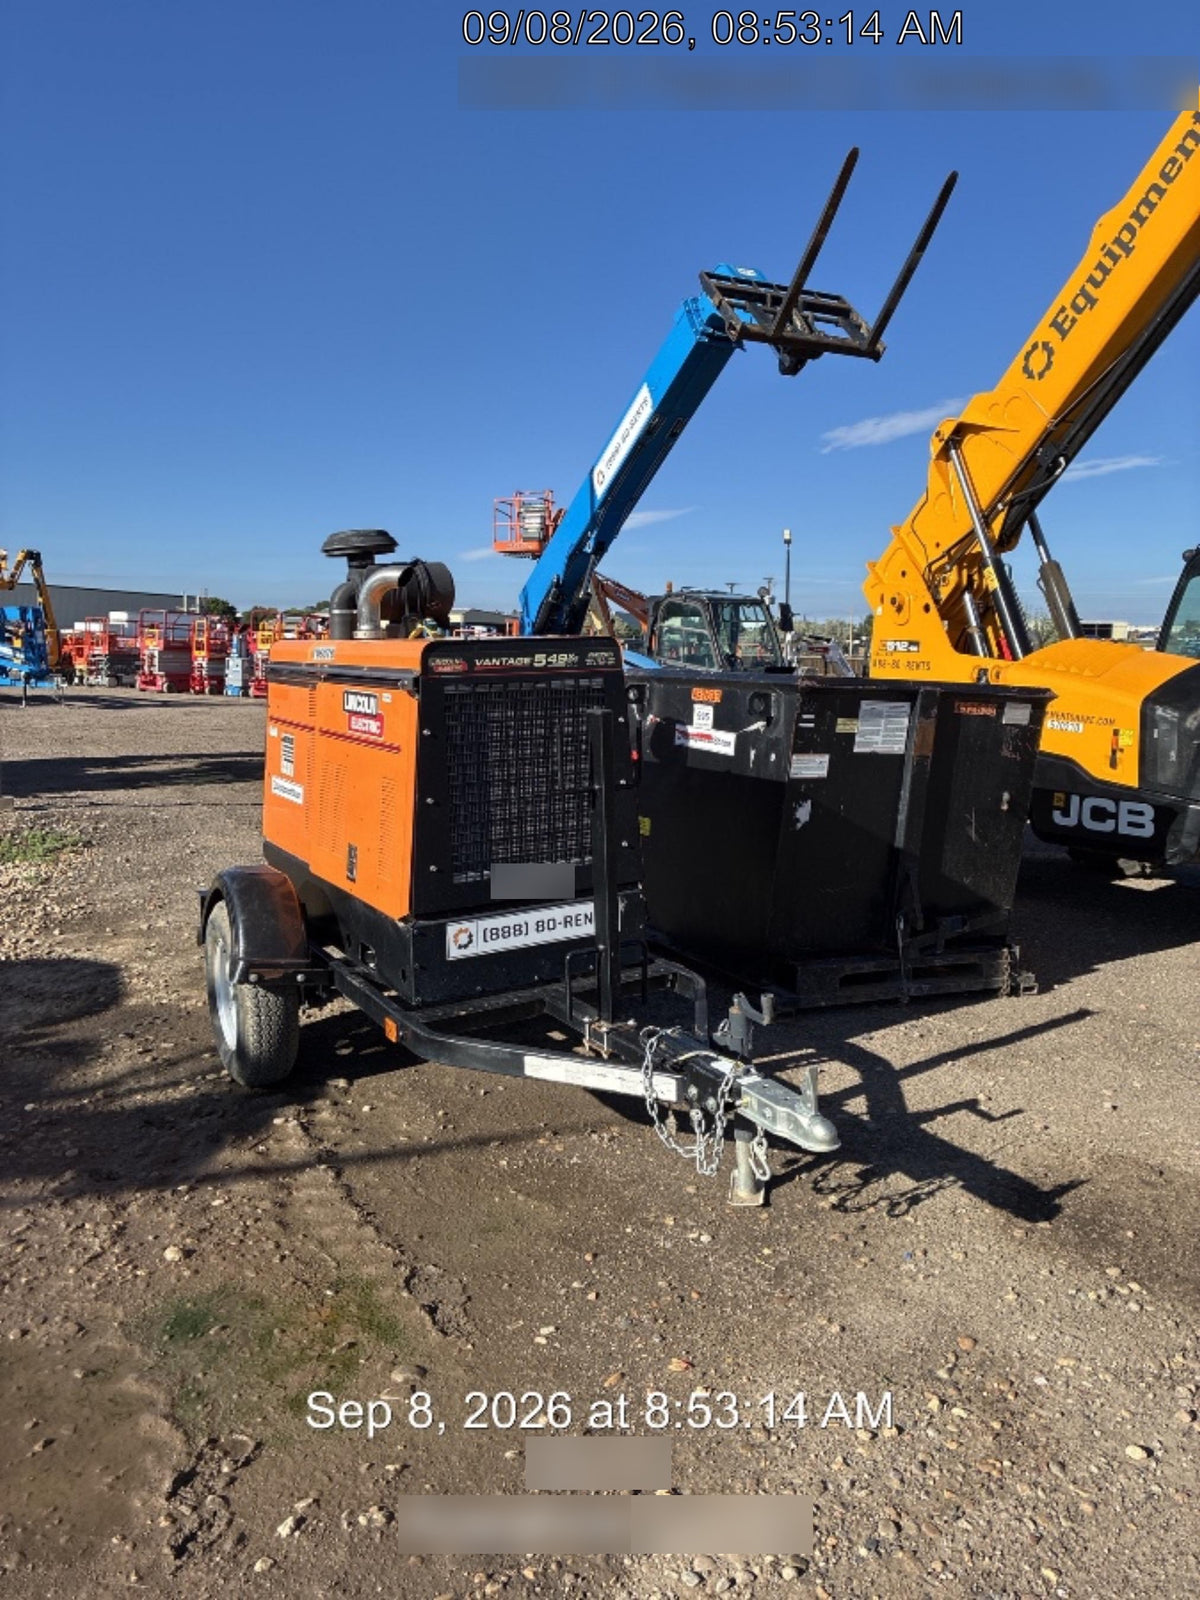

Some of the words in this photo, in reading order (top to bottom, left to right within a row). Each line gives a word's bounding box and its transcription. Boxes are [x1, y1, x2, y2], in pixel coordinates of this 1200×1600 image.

[475, 656, 532, 667] VANTAGE
[344, 691, 377, 715] LINCOLN
[351, 716, 381, 735] ELECTRIC
[1052, 794, 1155, 838] JCB
[483, 922, 529, 942] (888)
